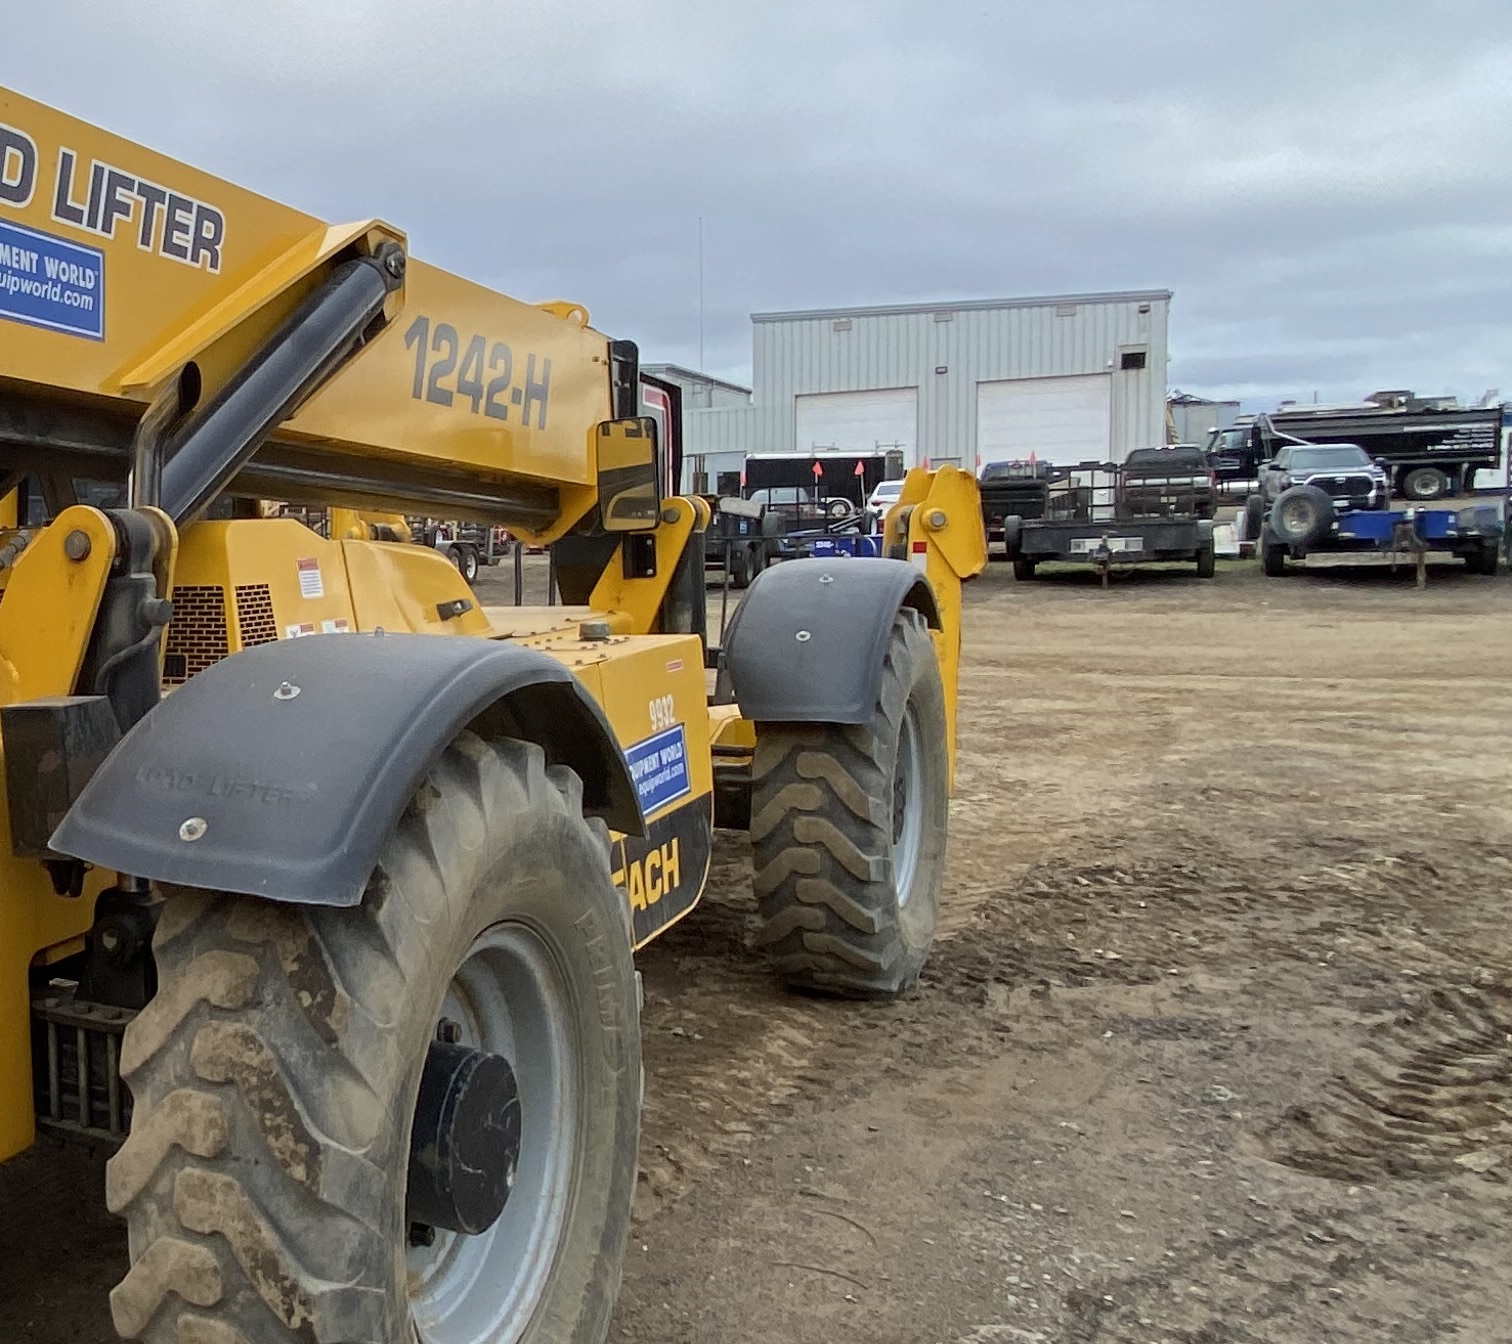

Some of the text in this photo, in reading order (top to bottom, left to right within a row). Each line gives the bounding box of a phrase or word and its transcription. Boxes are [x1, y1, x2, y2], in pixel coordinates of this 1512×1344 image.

[50, 145, 226, 274] LIFTER
[43, 255, 97, 291] WORLD
[403, 314, 552, 431] 1242-H
[649, 693, 676, 731] 9932
[659, 741, 683, 765] WORLD
